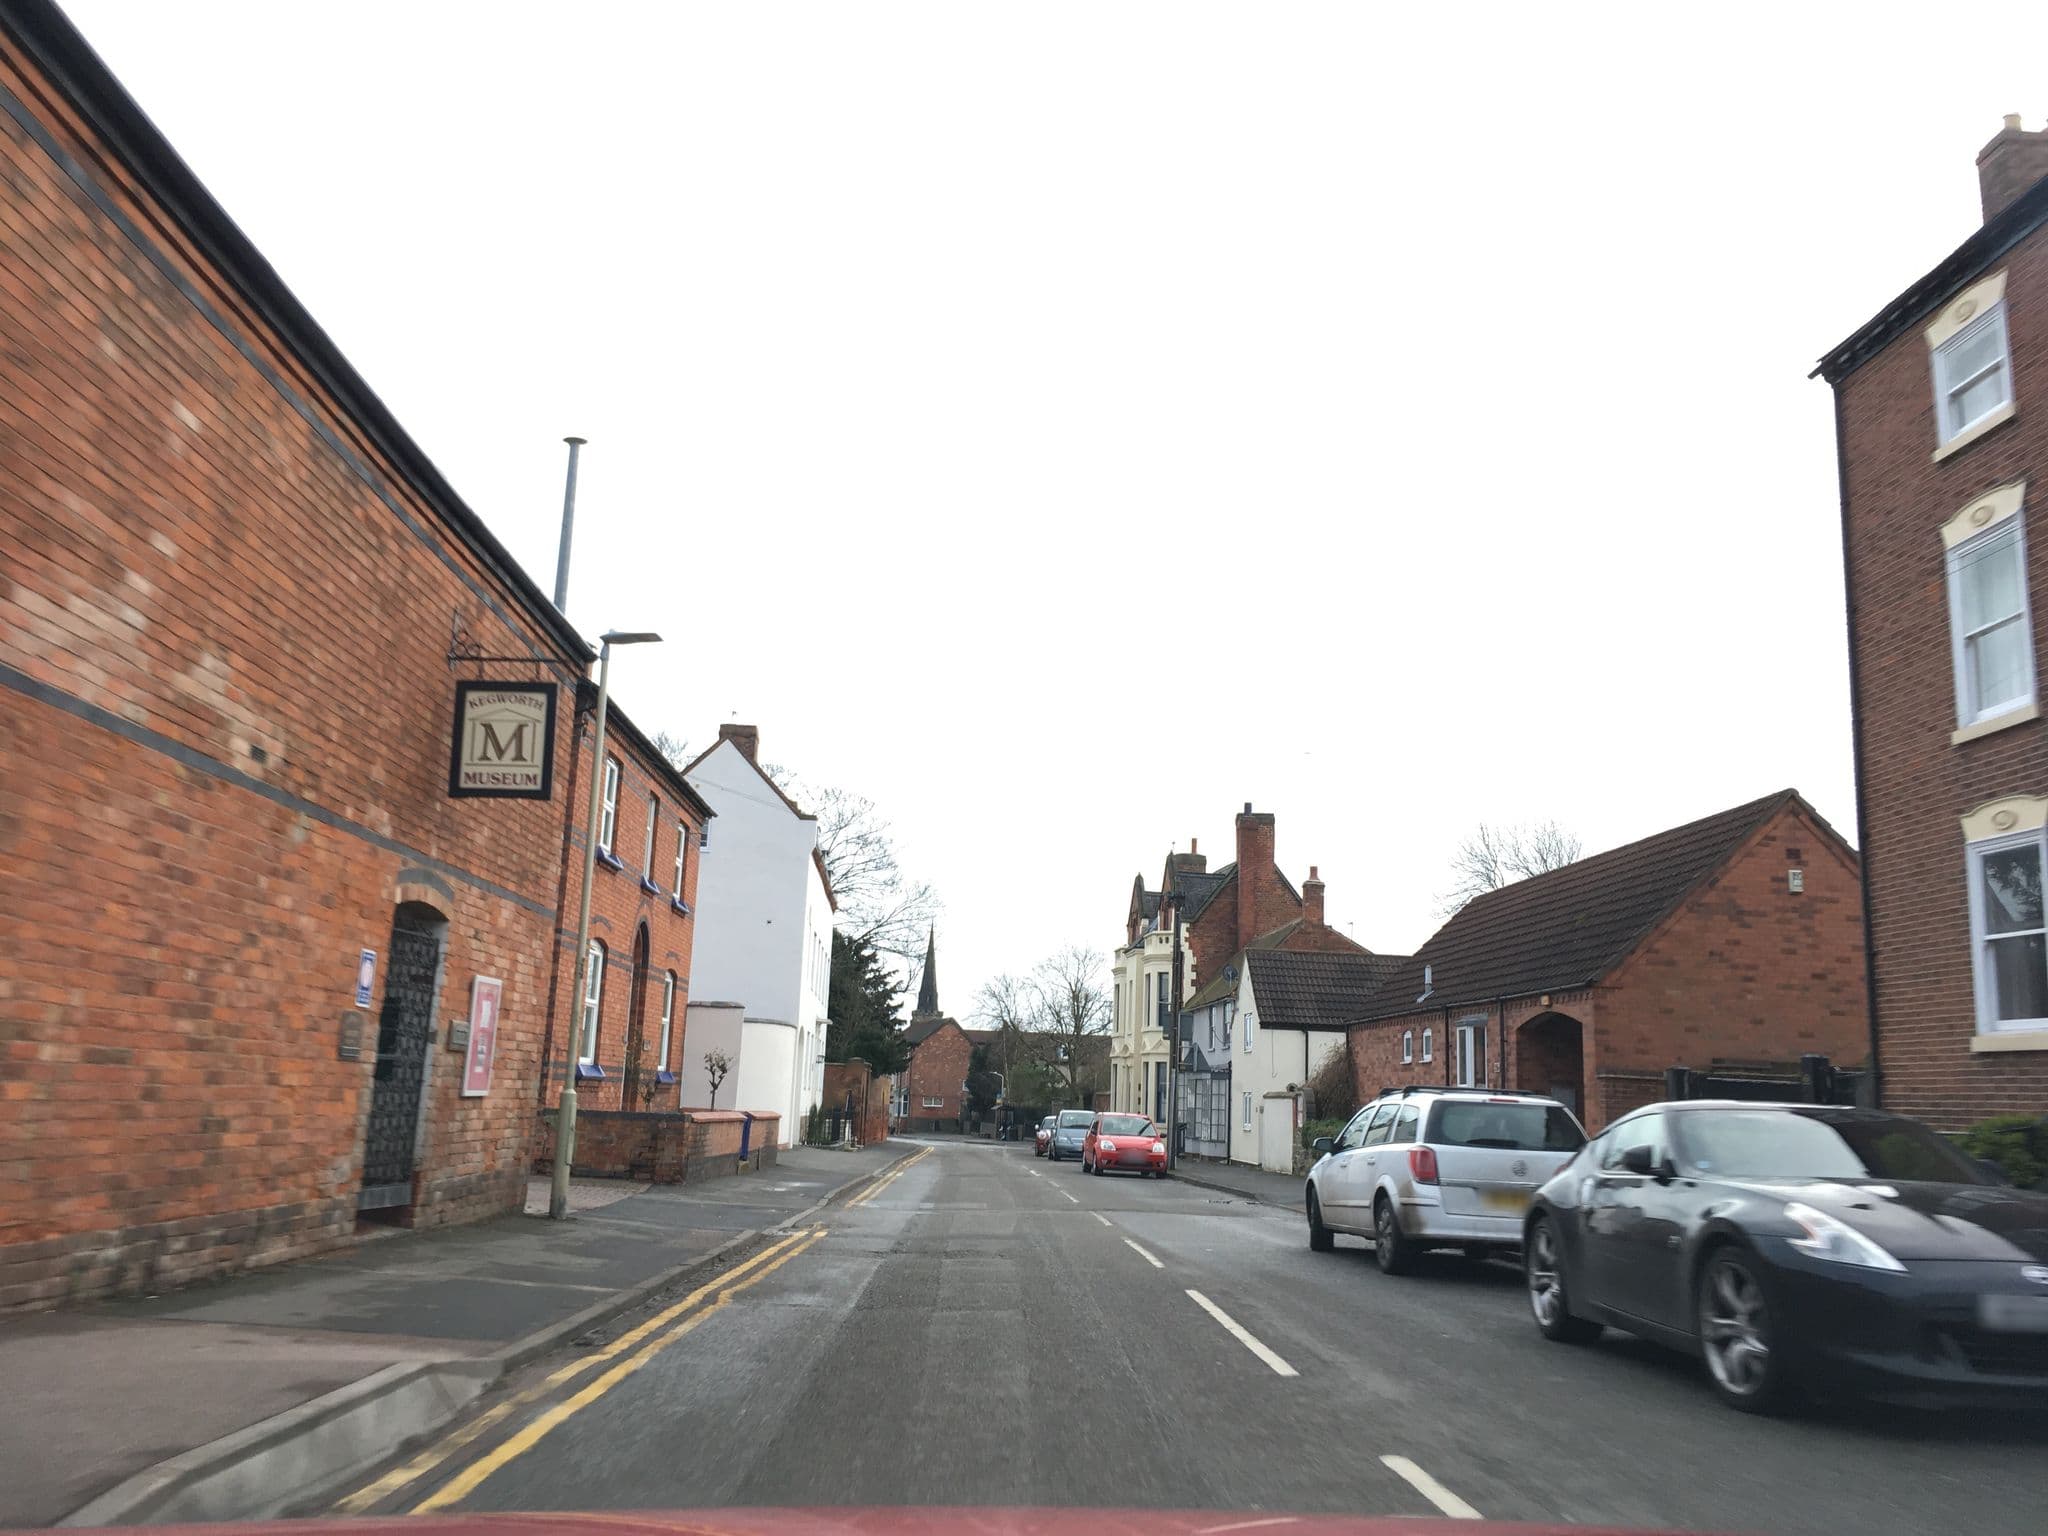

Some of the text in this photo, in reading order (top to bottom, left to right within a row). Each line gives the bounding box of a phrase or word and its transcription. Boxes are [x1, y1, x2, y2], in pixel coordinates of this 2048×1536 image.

[468, 693, 544, 711] KEGWORTH
[478, 722, 528, 762] M
[464, 771, 538, 786] MUSEUM
